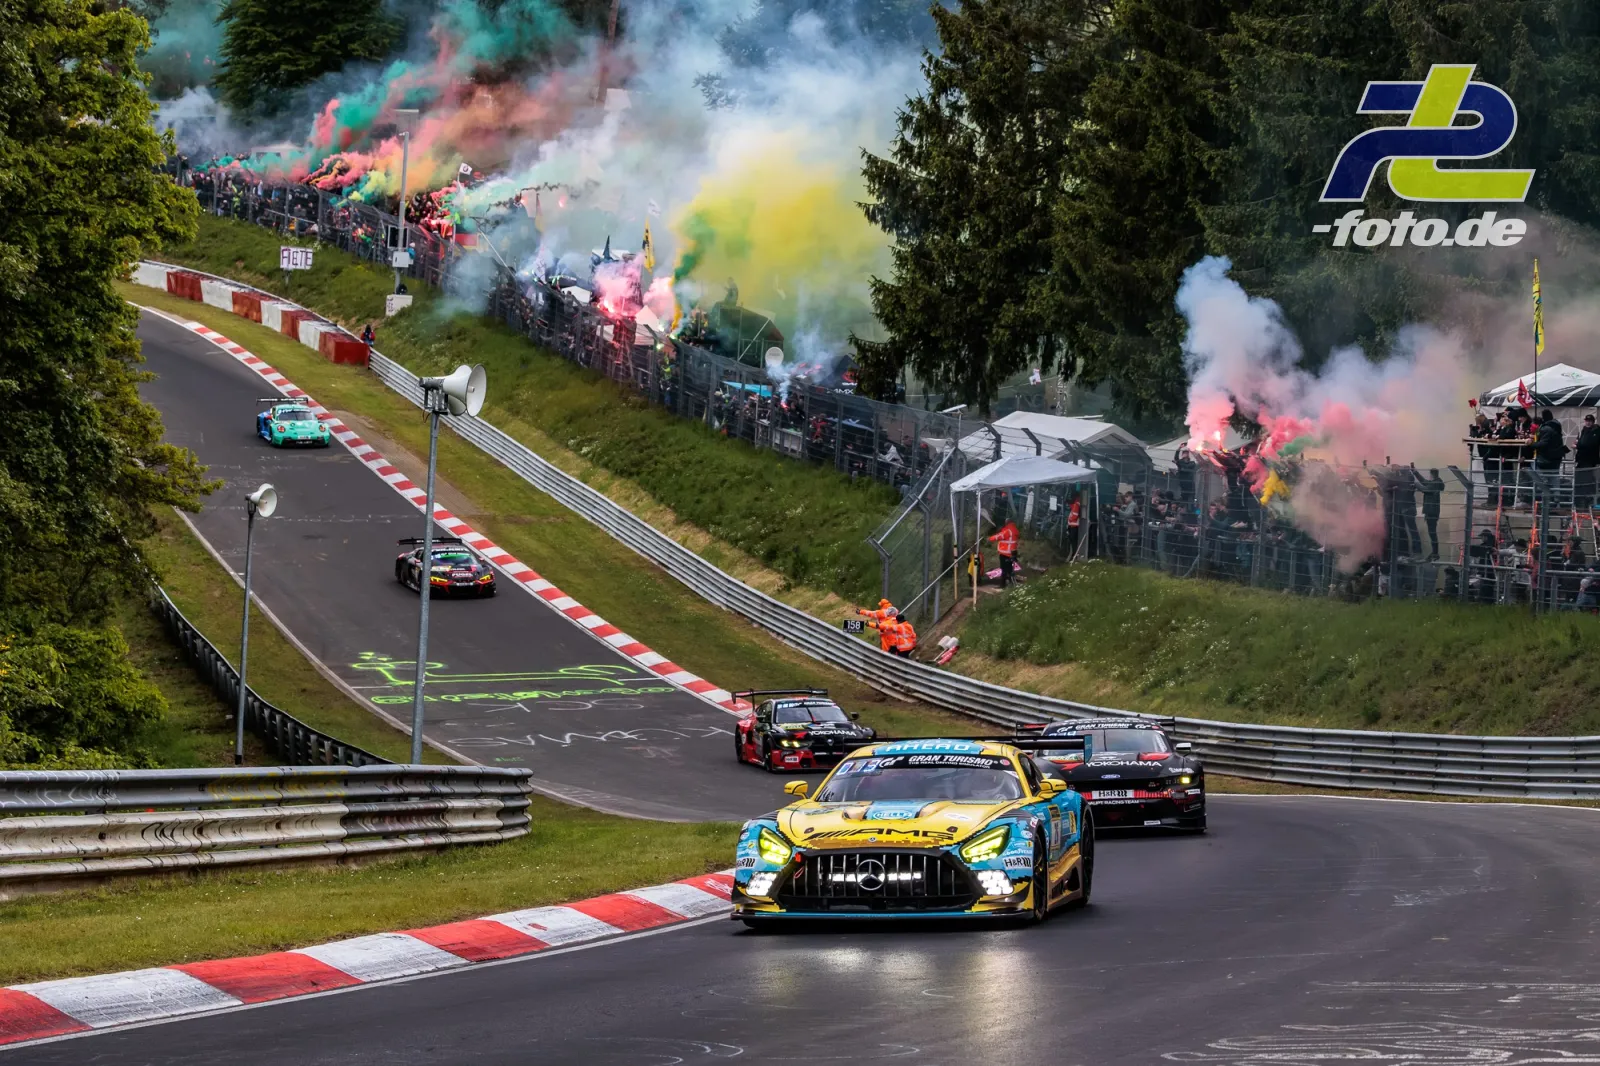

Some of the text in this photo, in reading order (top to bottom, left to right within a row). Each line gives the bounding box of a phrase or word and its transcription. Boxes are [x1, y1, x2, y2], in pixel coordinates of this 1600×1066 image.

[847, 620, 861, 630] 158
[808, 729, 857, 737] YOKOHAMA
[886, 743, 970, 753] AHEAD
[908, 755, 994, 766] GRAN TURISMO
[1086, 760, 1163, 768] YOKOHAMA
[846, 827, 954, 841] AMG
